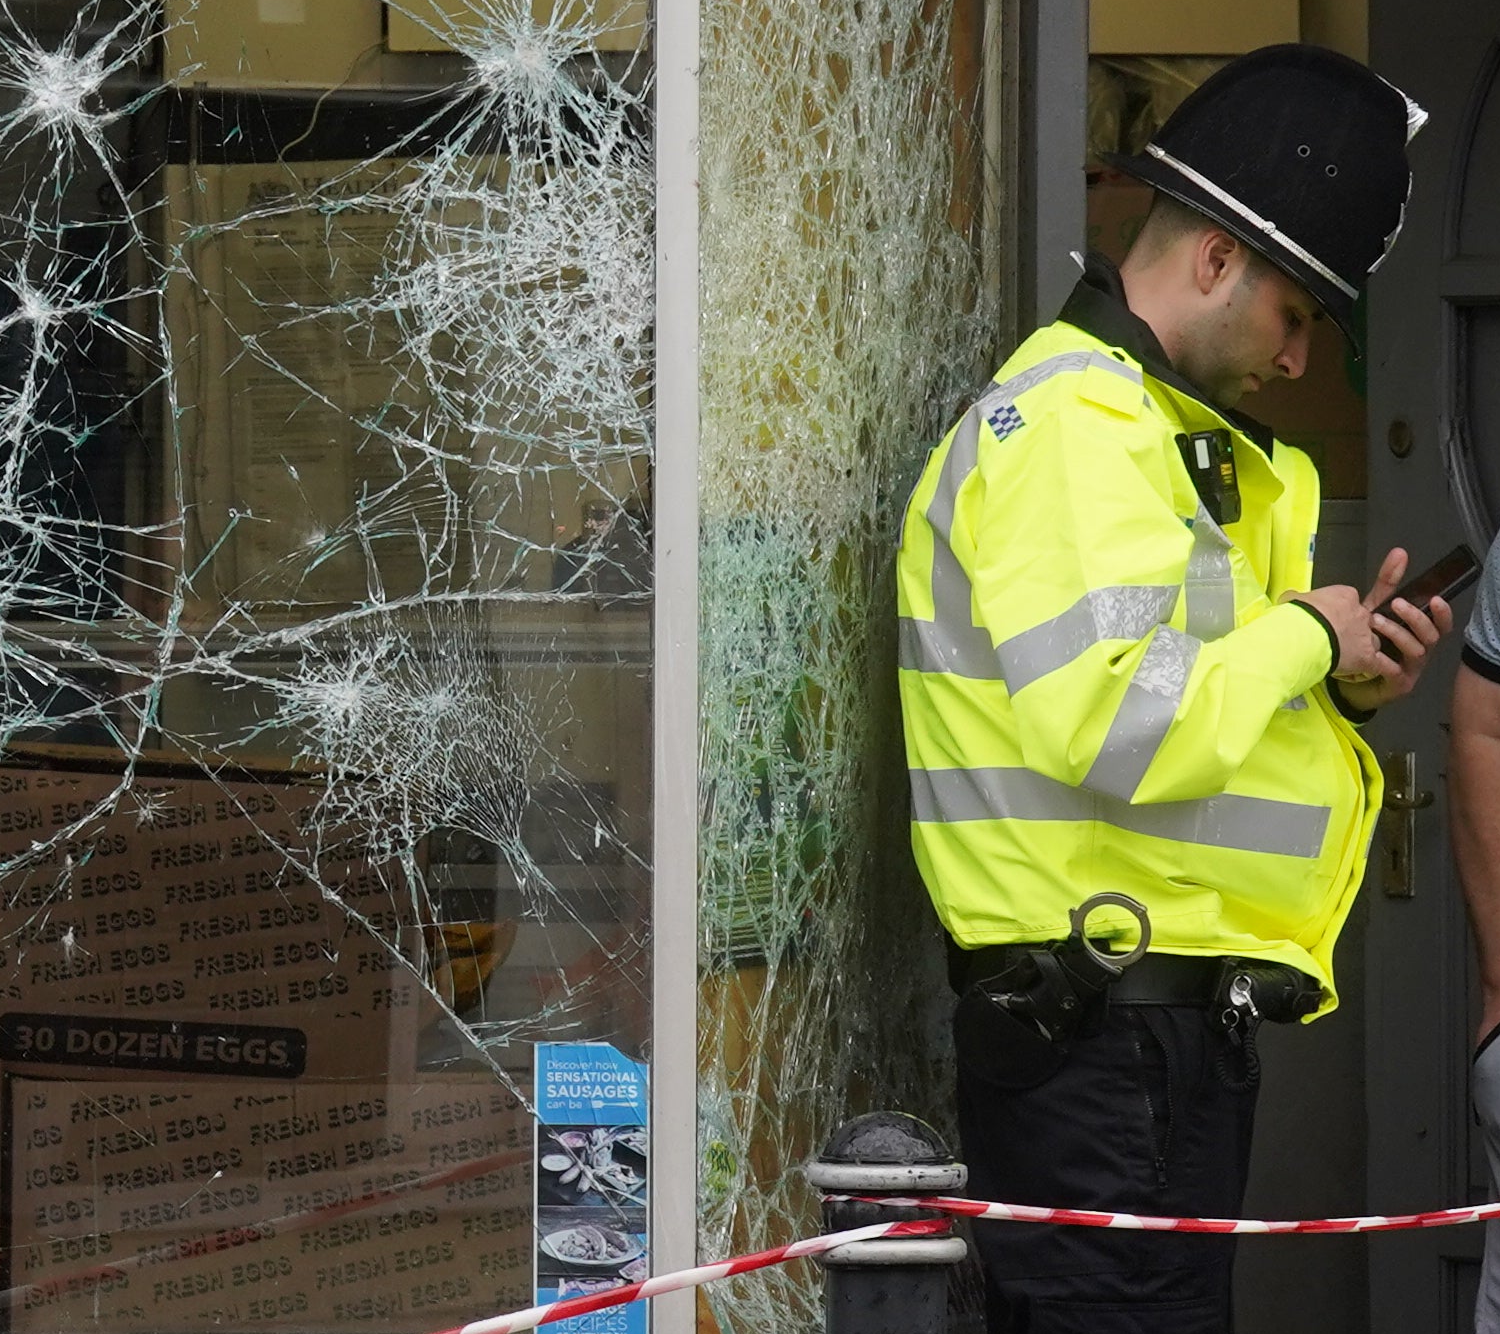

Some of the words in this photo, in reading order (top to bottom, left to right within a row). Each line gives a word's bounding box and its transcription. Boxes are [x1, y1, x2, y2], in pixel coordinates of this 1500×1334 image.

[215, 794, 276, 821] EGGS
[151, 840, 221, 870] FRESH
[81, 870, 141, 898] EGGS
[165, 877, 236, 905] FRESH
[96, 906, 156, 934] EGGS
[180, 913, 250, 942] FRESH
[258, 902, 320, 931] EGGS
[31, 953, 102, 984] FRESH
[111, 943, 170, 971] EGGS
[194, 949, 264, 978] FRESH
[273, 938, 334, 967] EGGS
[125, 979, 185, 1007] EGGS
[209, 985, 279, 1011] FRESH
[288, 975, 349, 1004] EGGS
[15, 1026, 56, 1052] 30
[67, 1029, 183, 1060] DOZEN
[196, 1035, 288, 1066] EGGS
[547, 1060, 592, 1070] Discover
[596, 1061, 618, 1070] how
[547, 1072, 638, 1082] SENSATIONAL
[72, 1094, 141, 1123] FRESH
[547, 1085, 638, 1098] SAUSAGES
[547, 1100, 565, 1109] can
[569, 1099, 582, 1109] be
[87, 1123, 157, 1159] FRESH
[166, 1113, 227, 1142] EGGS
[250, 1112, 320, 1146] FRESH
[328, 1098, 387, 1129] EGGS
[413, 1098, 482, 1131] FRESH
[104, 1162, 174, 1195] FRESH
[182, 1147, 243, 1178] EGGS
[268, 1148, 338, 1181] FRESH
[345, 1133, 406, 1166] EGGS
[430, 1133, 498, 1167] FRESH
[36, 1198, 96, 1227] EGGS
[121, 1201, 191, 1228] FRESH
[199, 1183, 260, 1214] EGGS
[284, 1184, 353, 1216] FRESH
[447, 1170, 515, 1202] FRESH
[52, 1233, 113, 1263] EGGS
[216, 1222, 276, 1251] EGGS
[300, 1219, 370, 1254] FRESH
[379, 1205, 438, 1236] EGGS
[154, 1269, 224, 1304] FRESH
[232, 1256, 293, 1287] EGGS
[317, 1255, 386, 1290] FRESH
[395, 1241, 454, 1272] EGGS
[249, 1292, 308, 1320] EGGS
[411, 1276, 470, 1308] EGGS
[556, 1316, 628, 1331] RECIPES
